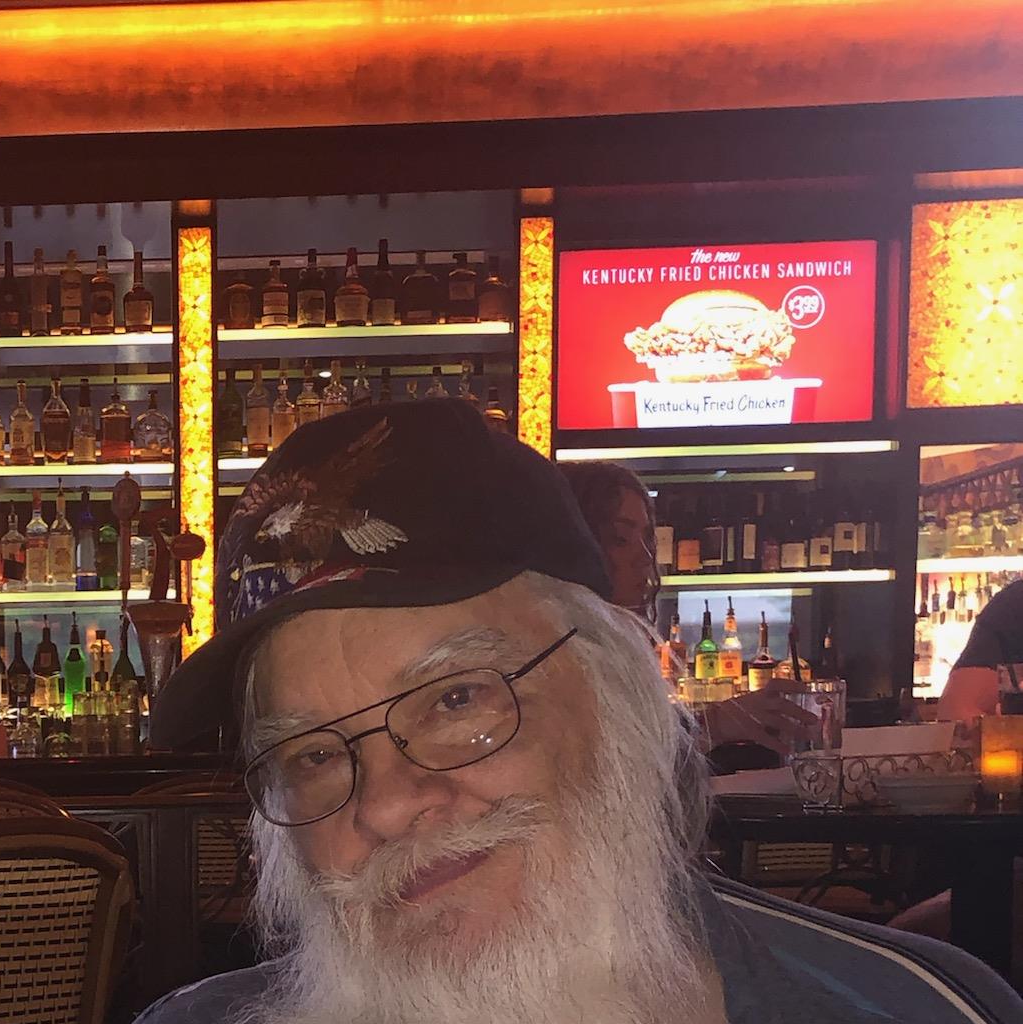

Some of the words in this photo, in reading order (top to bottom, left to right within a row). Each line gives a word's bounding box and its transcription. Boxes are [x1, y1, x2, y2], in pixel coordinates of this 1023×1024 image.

[690, 248, 713, 264] the
[714, 250, 740, 263] new
[582, 267, 653, 285] KENTUCKY
[660, 265, 702, 282] FRIED
[709, 263, 770, 281] CHICKEN
[777, 260, 852, 278] SANDWICH
[643, 397, 699, 414] Kentucky
[703, 396, 734, 412] Fried
[737, 395, 786, 411] Chicken
